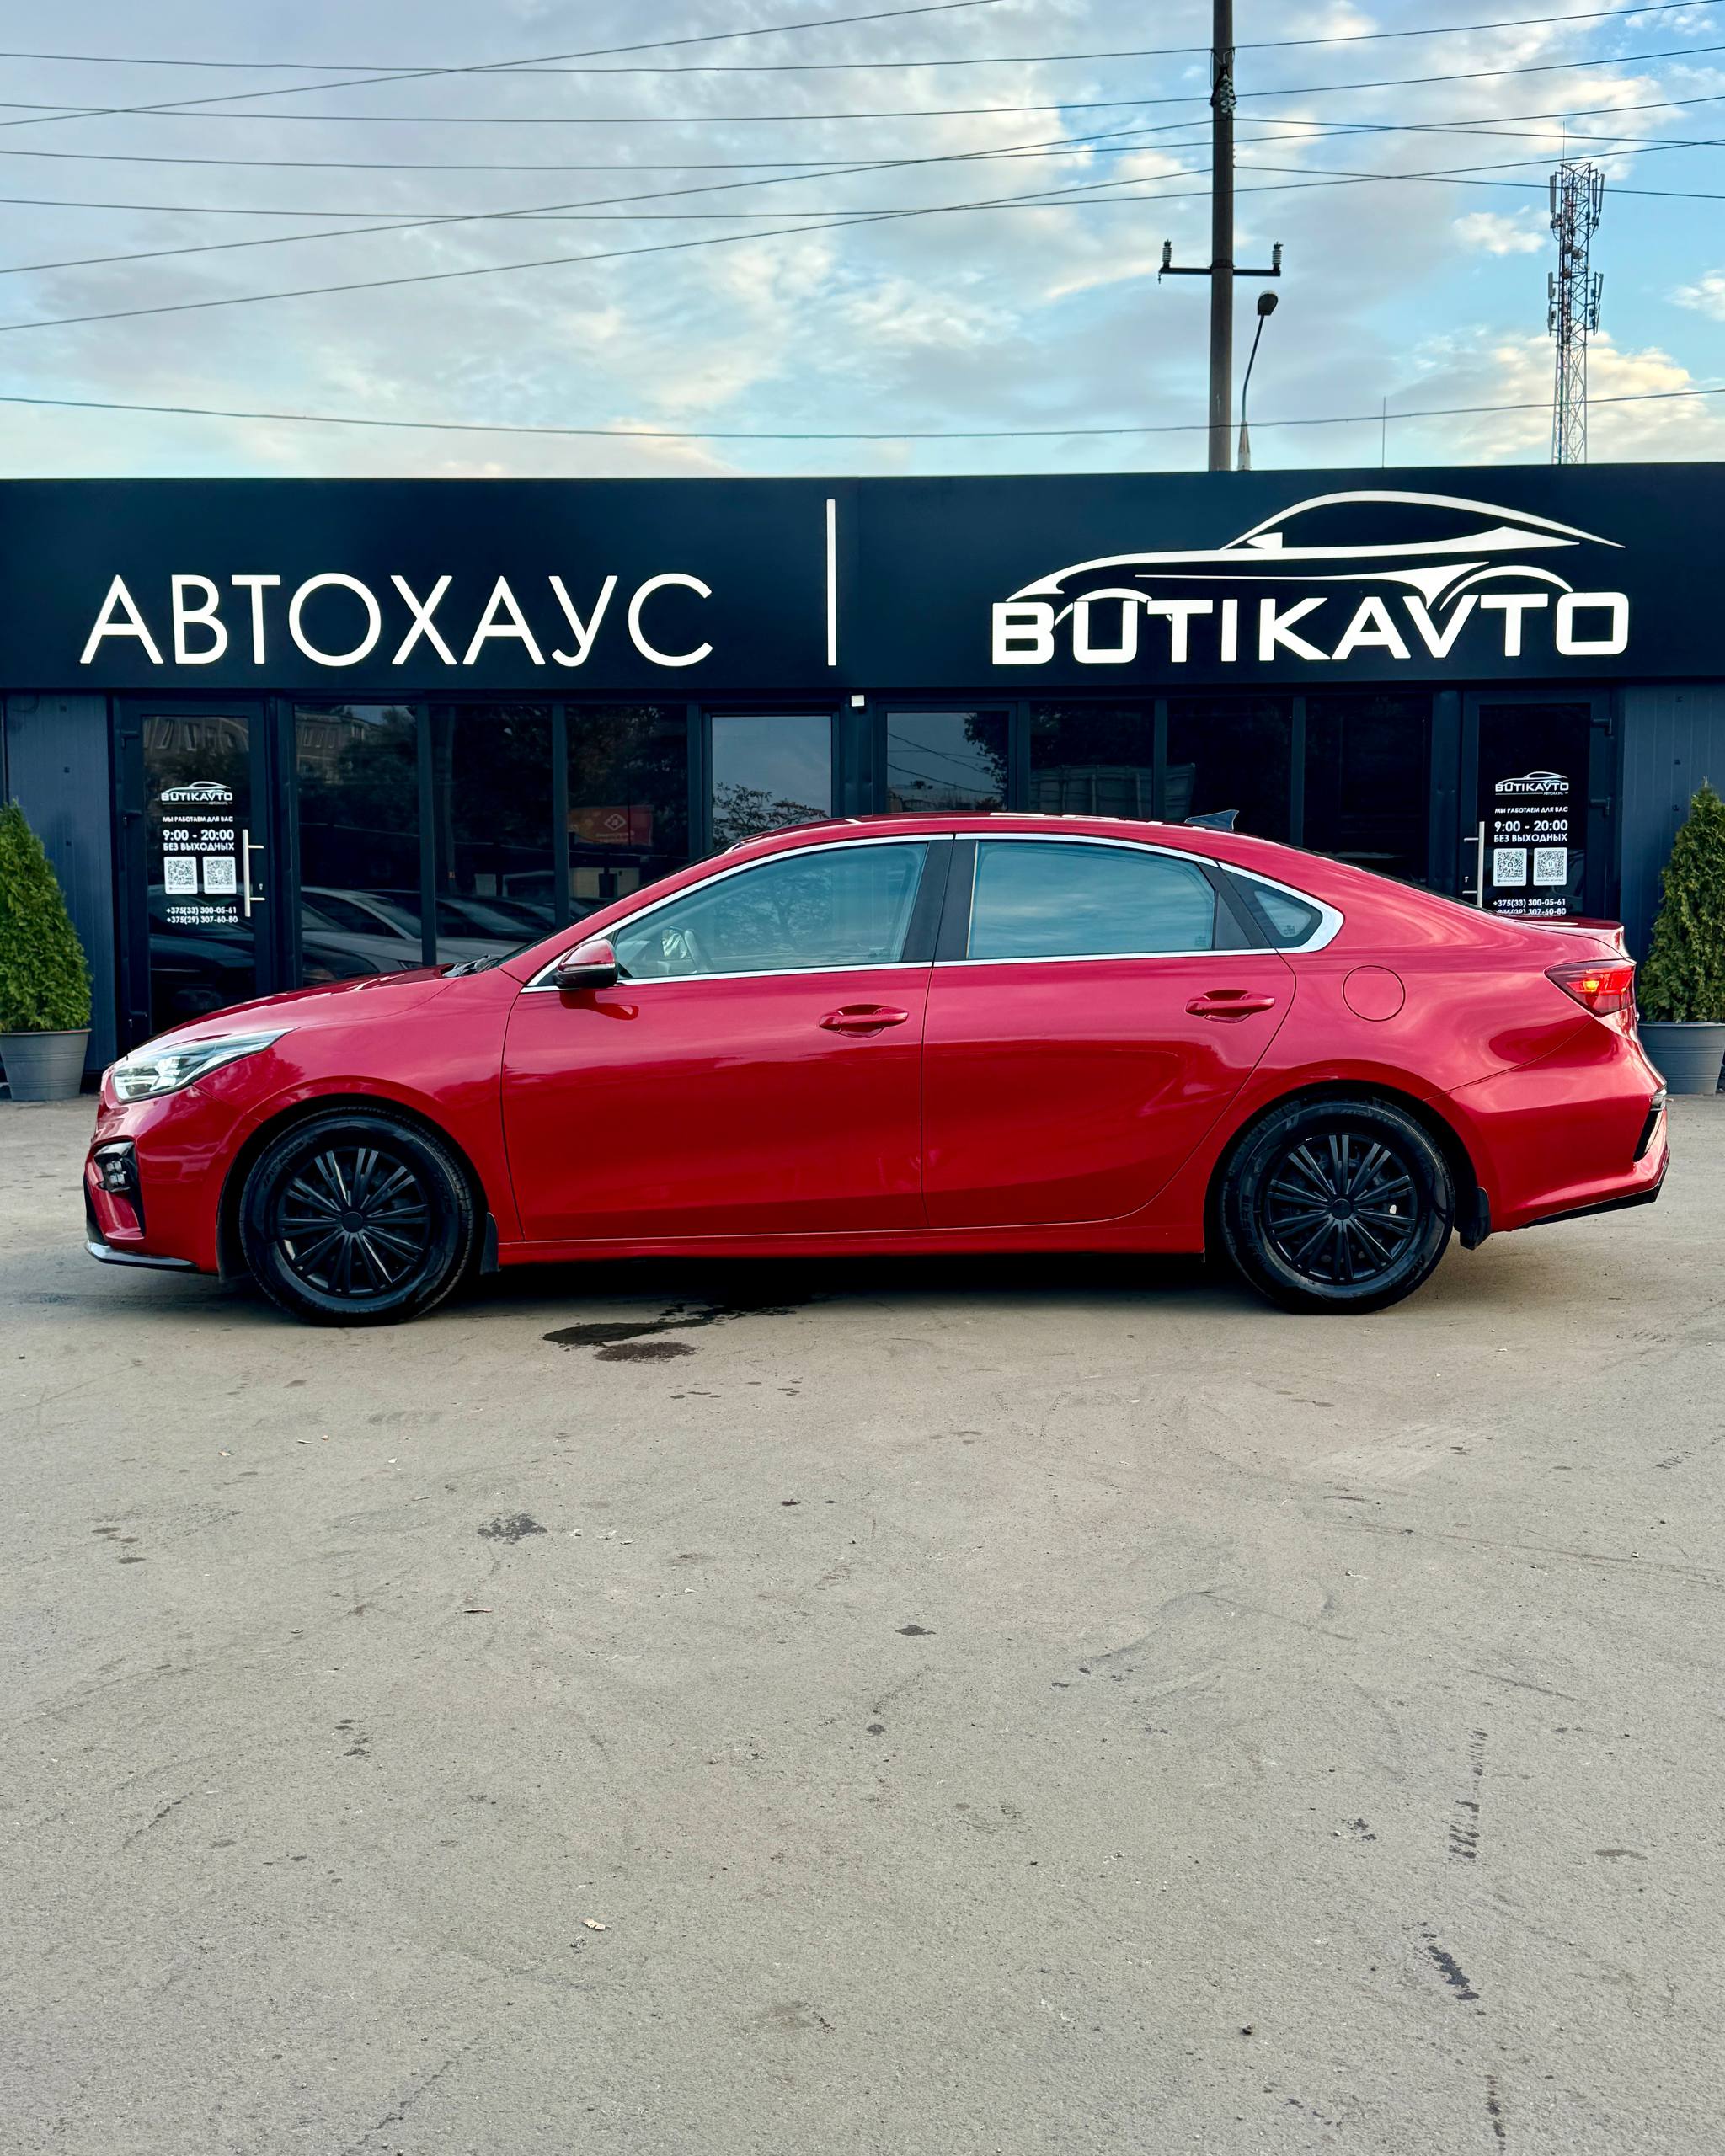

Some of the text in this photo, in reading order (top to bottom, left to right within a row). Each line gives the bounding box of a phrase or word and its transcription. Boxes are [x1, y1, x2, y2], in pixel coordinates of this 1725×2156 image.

[79, 572, 713, 668] АВТОХАУС
[991, 590, 1630, 665] BUTIKAVTO
[1494, 782, 1569, 792] BUTIKAVTO
[160, 792, 233, 802] BUTIKAVTO
[1494, 820, 1521, 832] 9:00
[1533, 819, 1568, 831] 20:00
[162, 829, 190, 841] 9:00
[200, 829, 235, 841] 20:00
[1512, 834, 1567, 842] ВЫХОДНЫХ
[163, 842, 235, 852] БЕЗ ВЫХОДНЫХ
[1493, 898, 1566, 908] +375(33) 300-05-61
[166, 906, 199, 915] +375(33)
[167, 915, 238, 925] +375(29) 307-60-80
